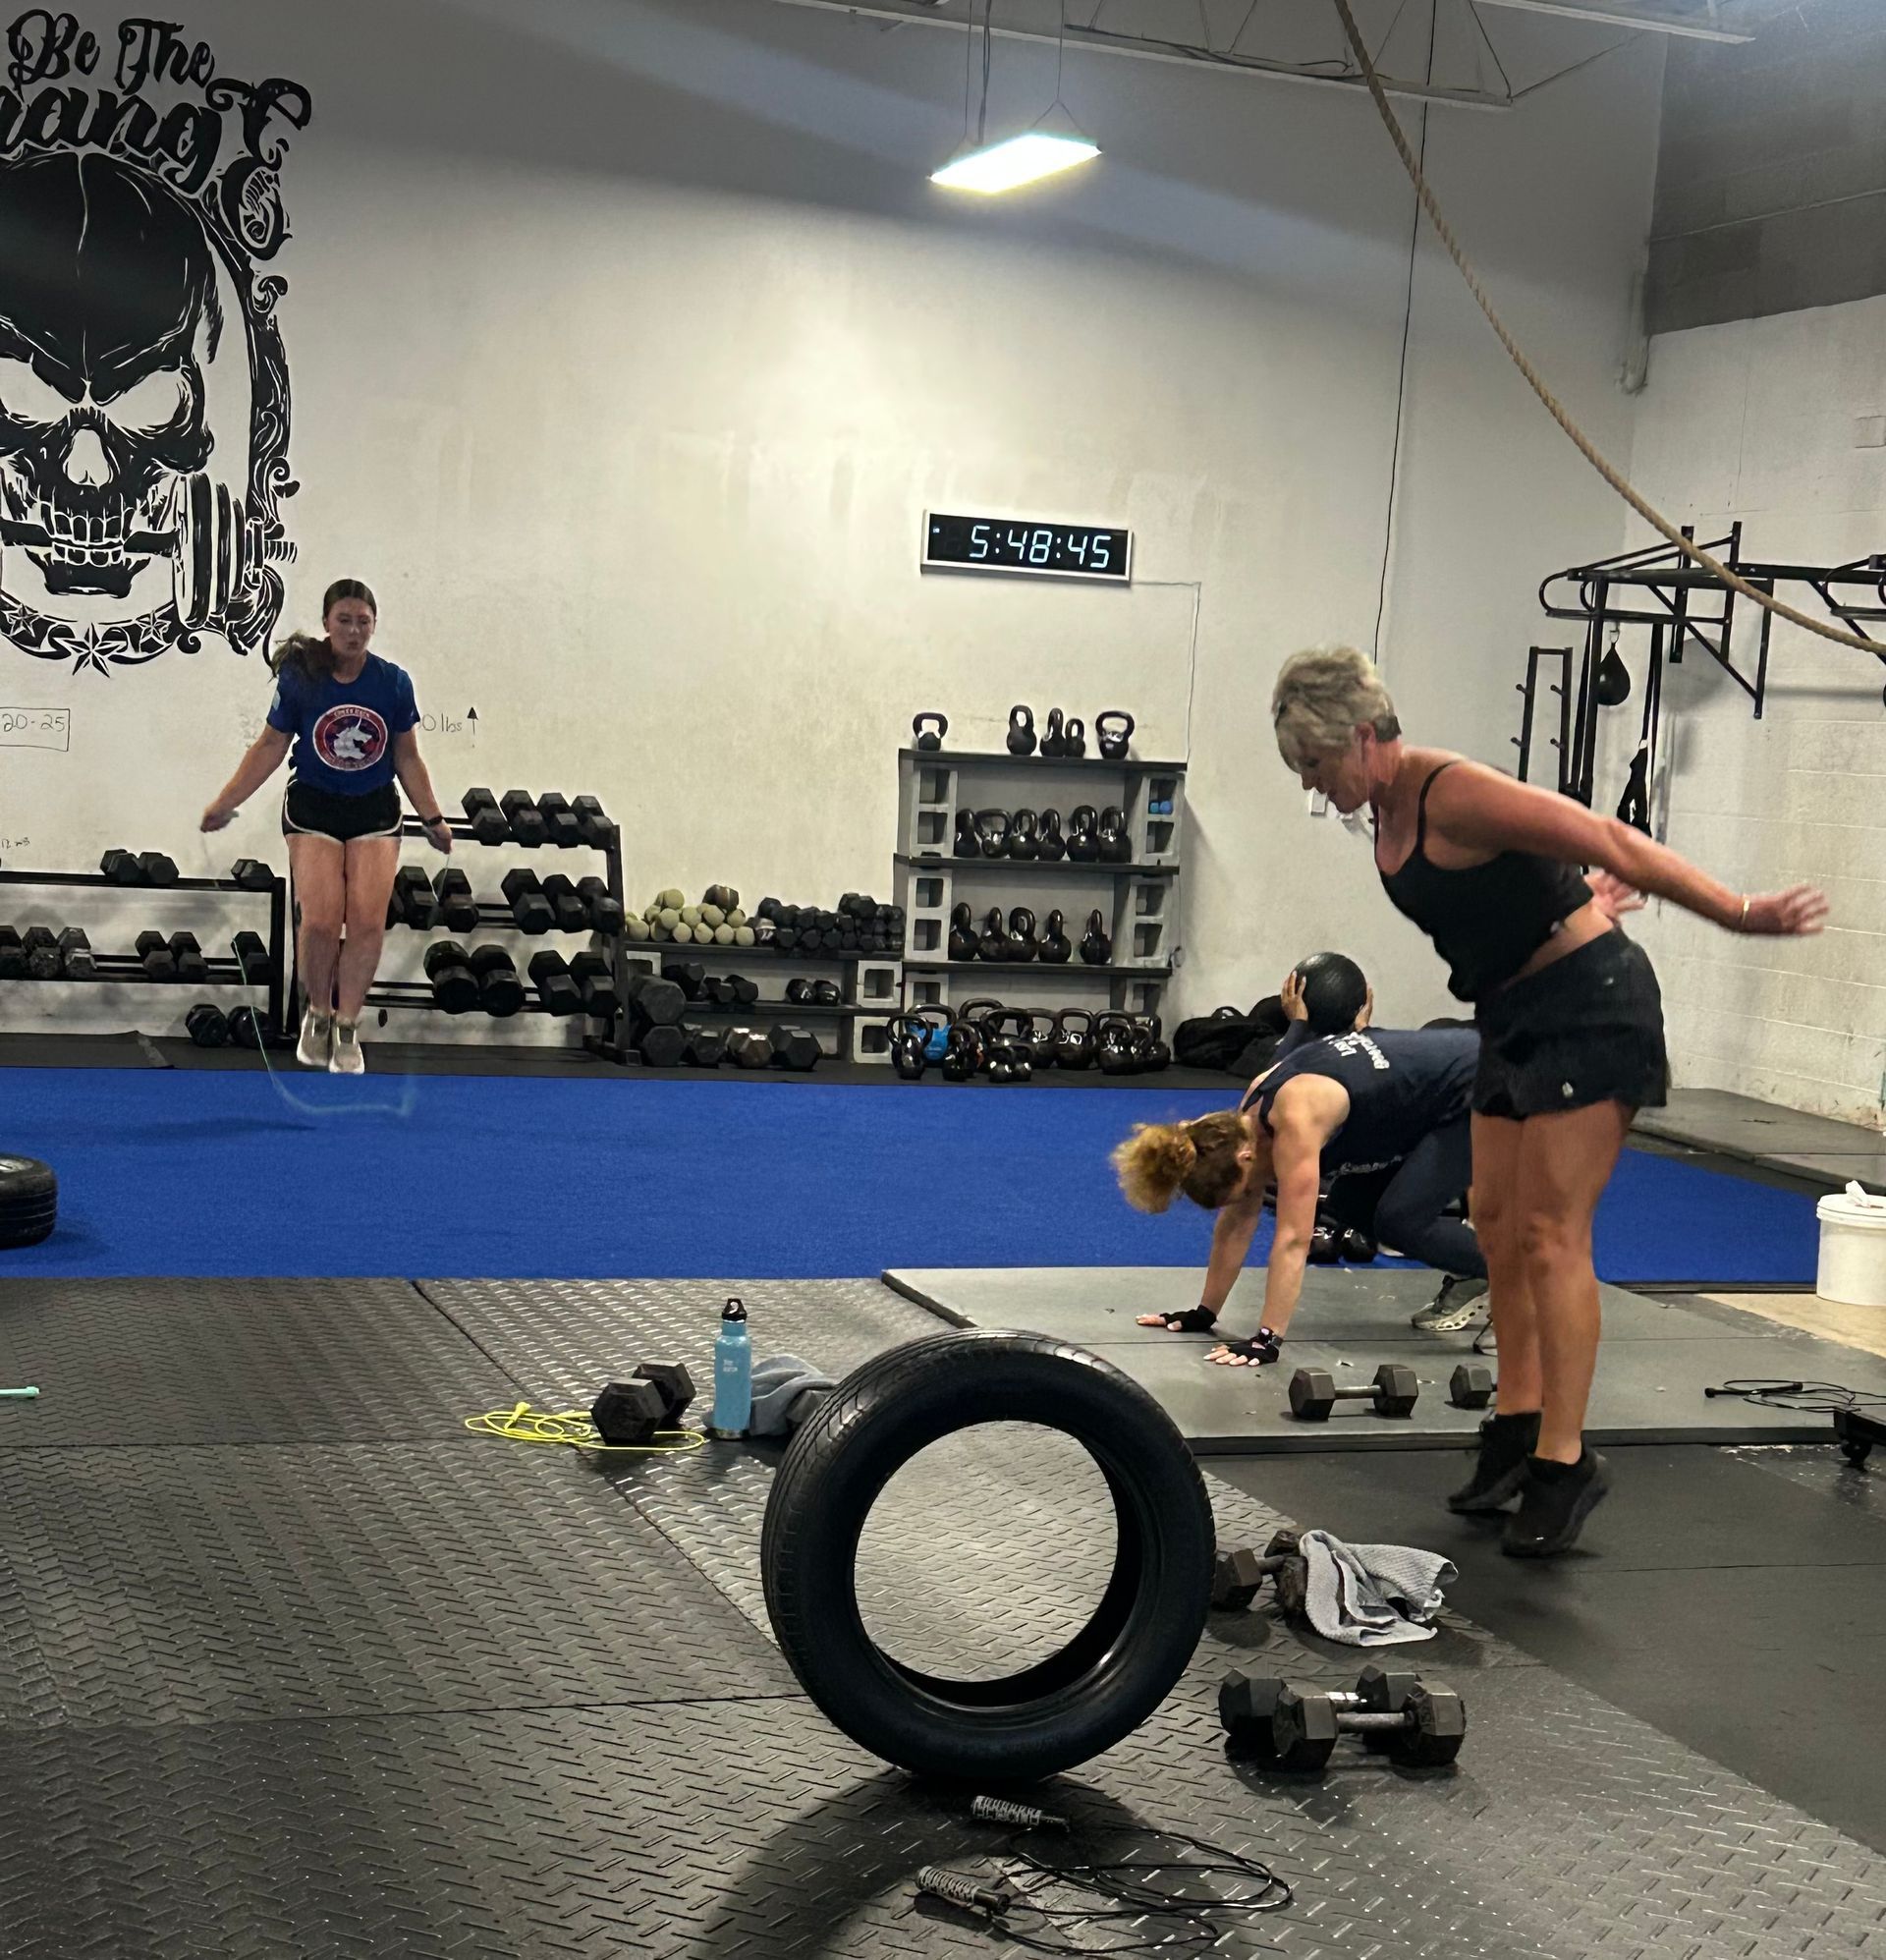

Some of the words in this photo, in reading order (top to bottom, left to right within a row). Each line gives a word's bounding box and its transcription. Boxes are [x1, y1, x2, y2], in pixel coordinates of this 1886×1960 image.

[6, 9, 100, 102] Be
[115, 18, 215, 95] The
[969, 525, 1112, 569] 5:48:45
[440, 711, 463, 733] lbs
